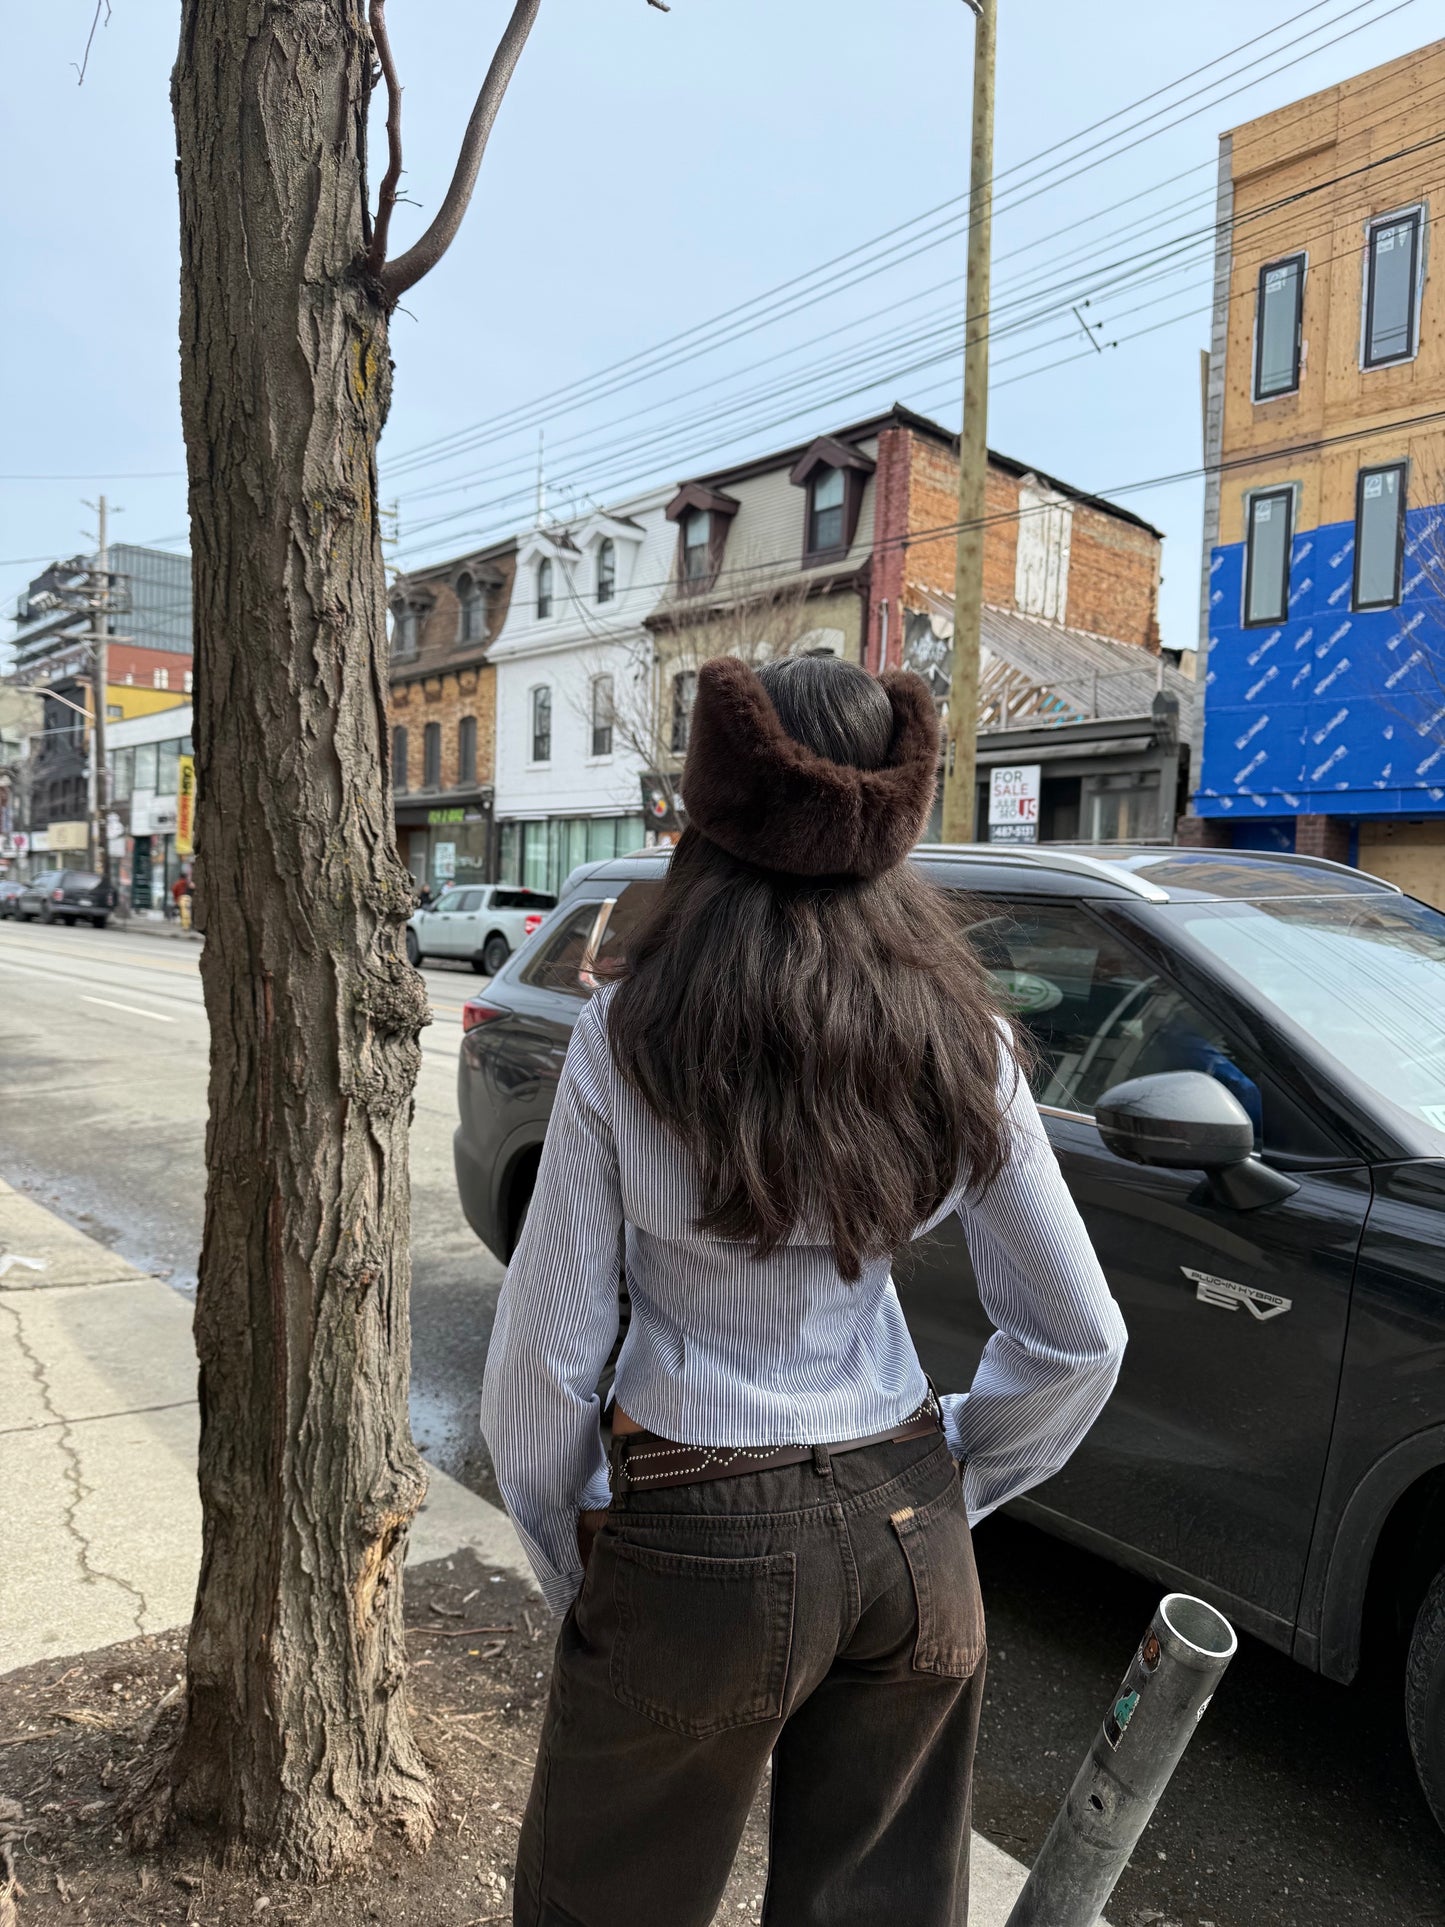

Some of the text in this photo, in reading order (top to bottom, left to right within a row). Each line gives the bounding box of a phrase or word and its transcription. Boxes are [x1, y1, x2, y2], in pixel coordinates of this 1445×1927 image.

[995, 770, 1023, 783] FOR
[994, 783, 1028, 797] SALE
[1191, 1271, 1284, 1306] PLUG-IN HYBRID
